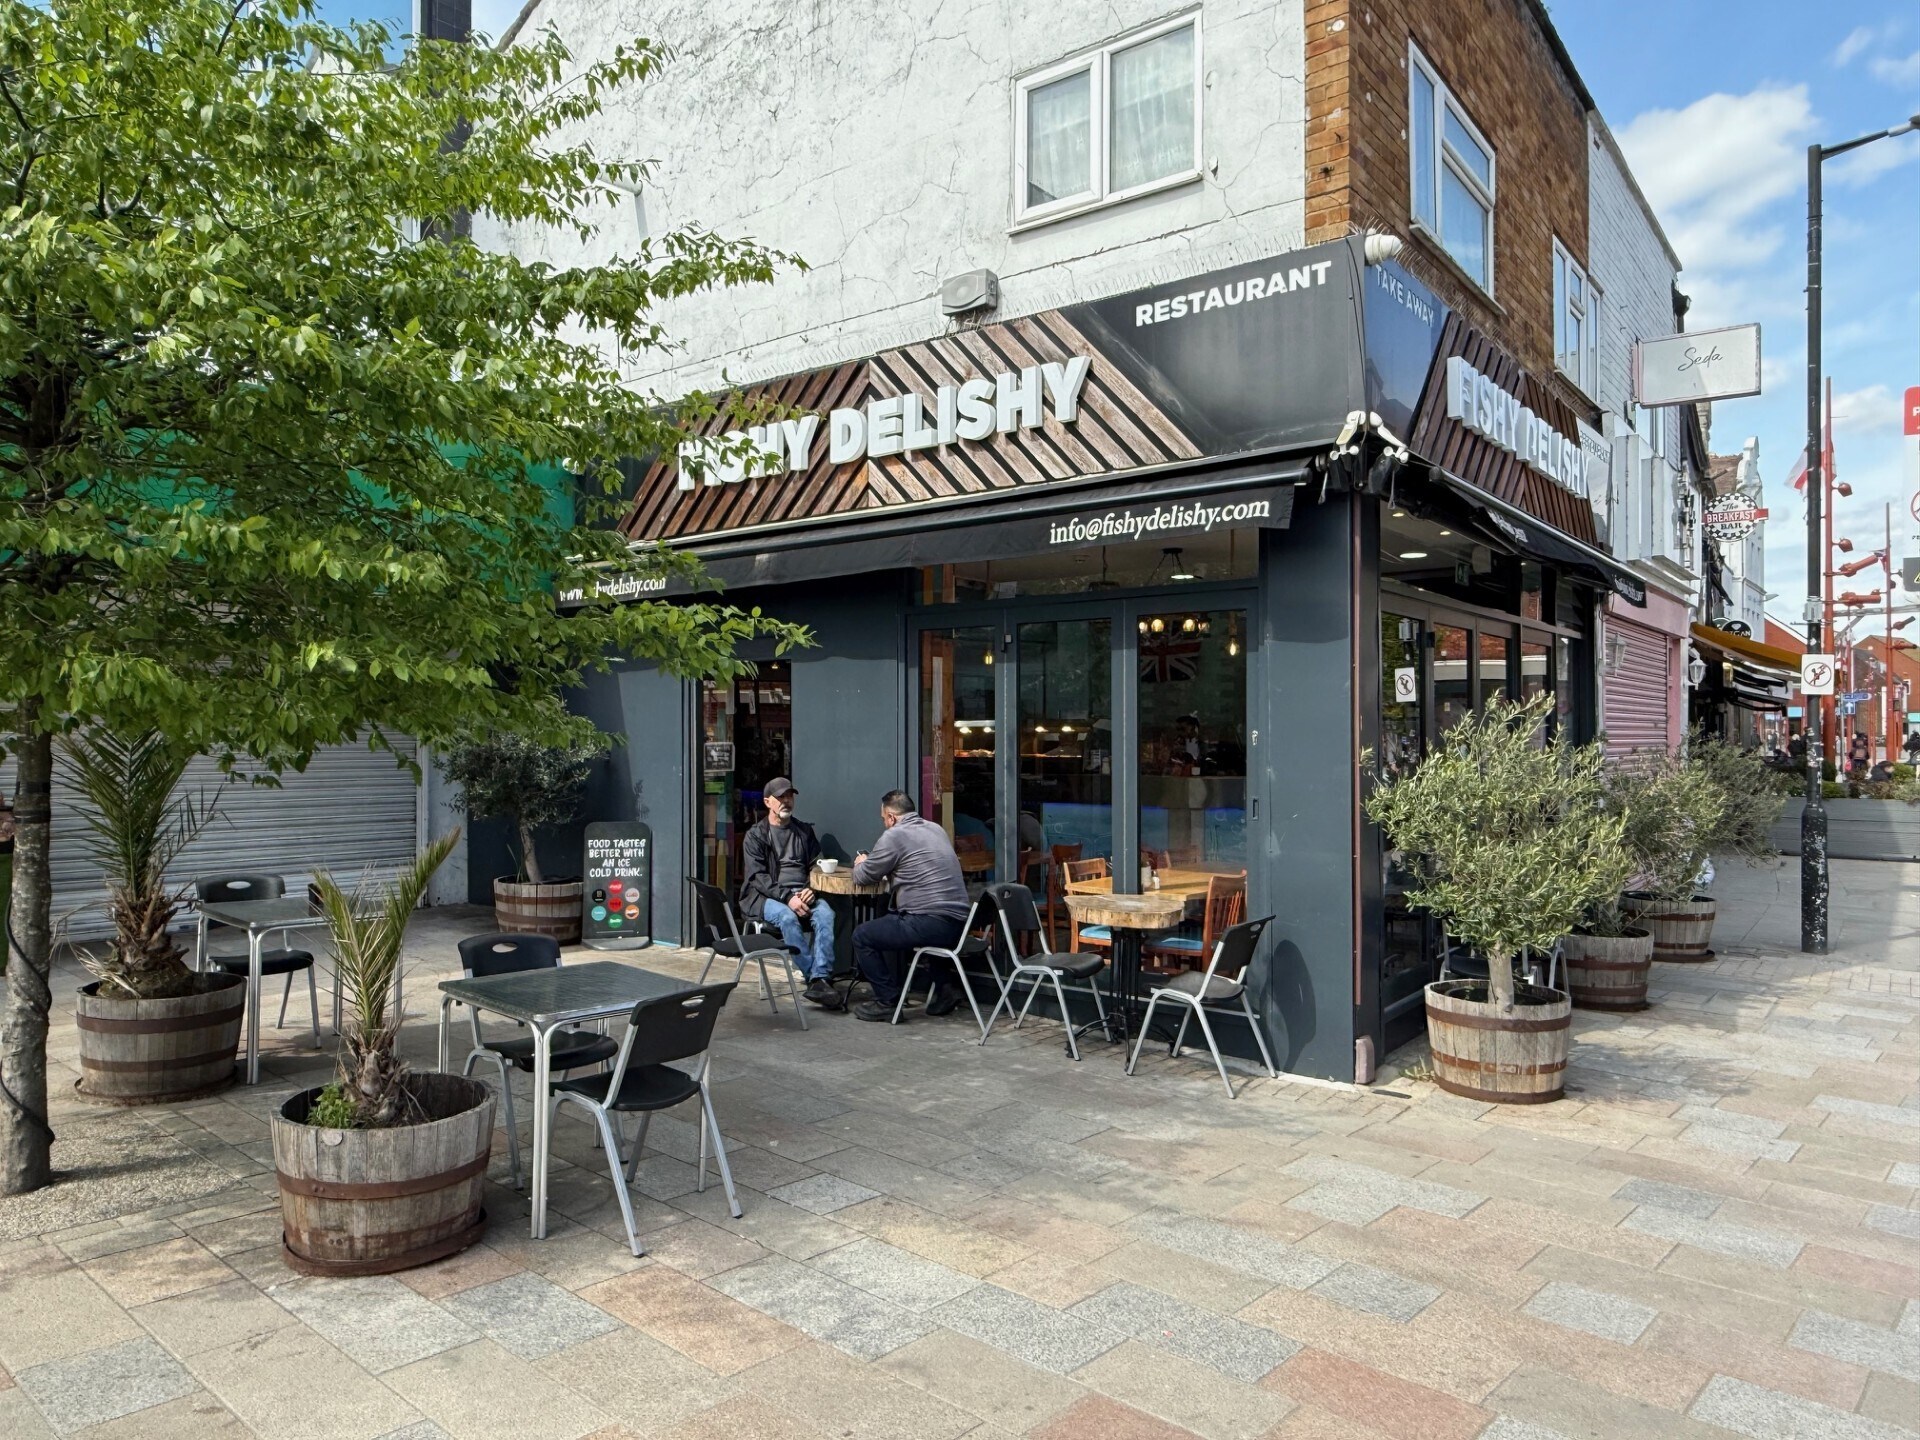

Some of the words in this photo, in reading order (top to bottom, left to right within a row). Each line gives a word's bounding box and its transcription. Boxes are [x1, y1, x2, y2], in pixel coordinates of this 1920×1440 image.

[1135, 260, 1332, 327] RESTAURANT
[1375, 263, 1404, 304] TAKE
[1406, 289, 1434, 328] AWAY
[678, 414, 820, 491] FISHY
[829, 355, 1092, 465] DELISHY
[1447, 355, 1521, 453] FISHY
[1516, 406, 1591, 500] DELISHY
[1049, 500, 1270, 545] info@fishydelishy.com
[1706, 509, 1757, 524] BREAKFAST
[588, 839, 611, 848] FOOD
[613, 838, 646, 848] TASTES
[588, 848, 620, 858] BETTER
[623, 848, 645, 858] WITH
[589, 868, 612, 878] COLD
[614, 867, 643, 877] DRINK.
[602, 858, 615, 868] AN
[618, 858, 631, 867] ICE
